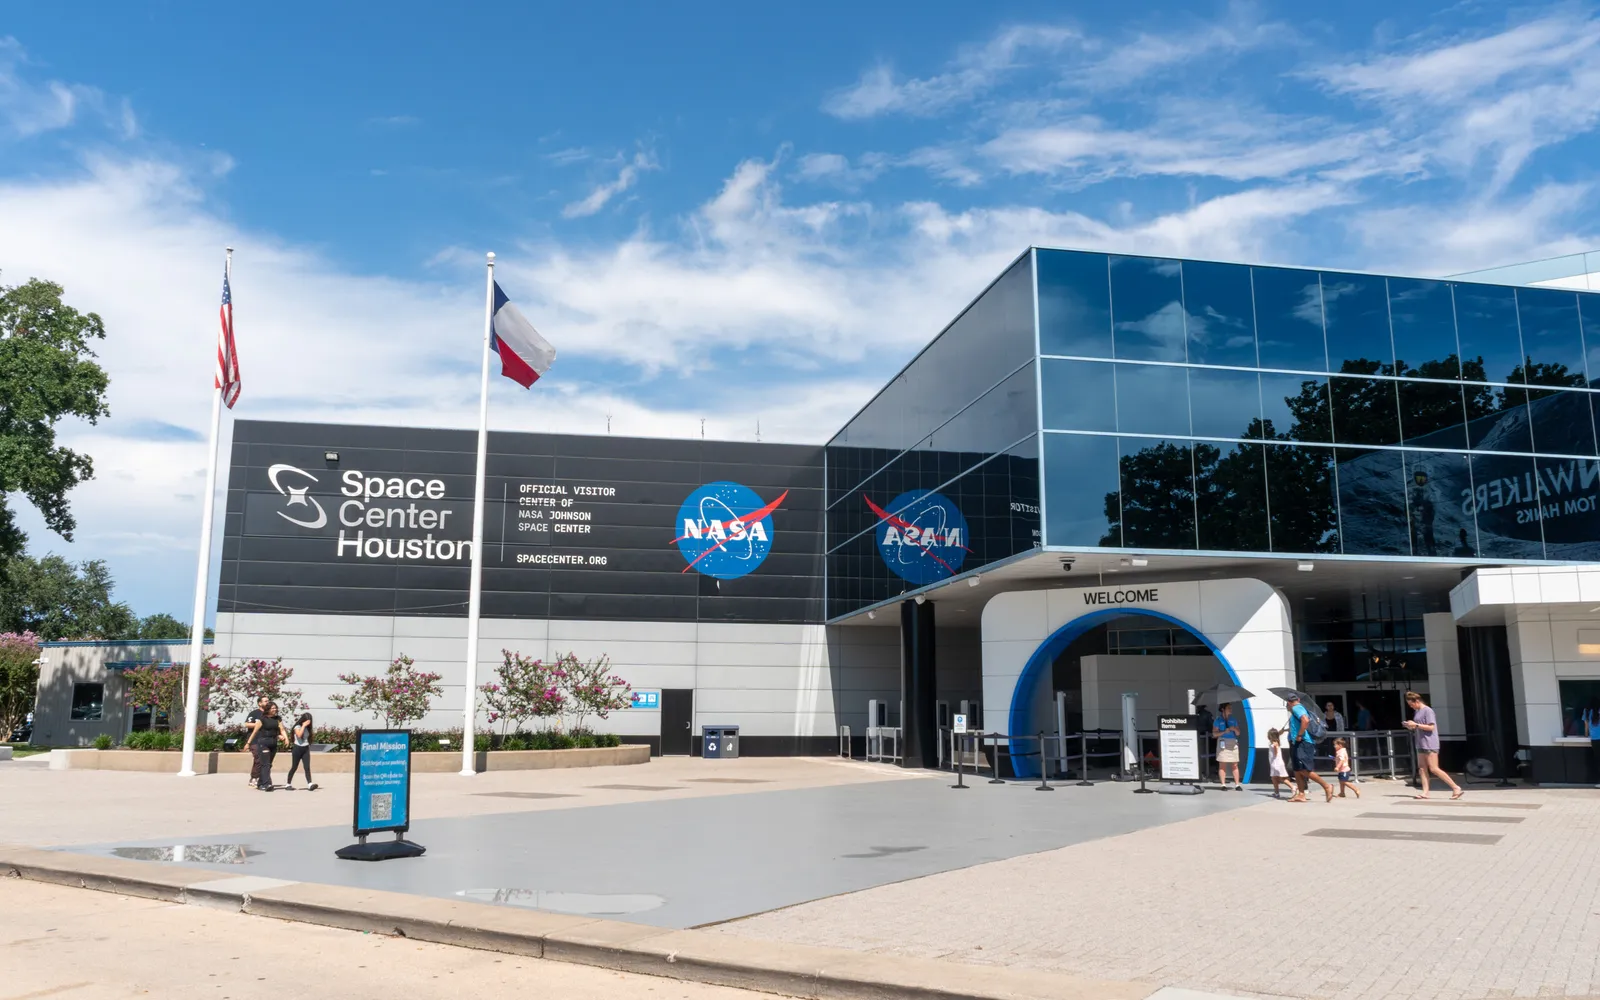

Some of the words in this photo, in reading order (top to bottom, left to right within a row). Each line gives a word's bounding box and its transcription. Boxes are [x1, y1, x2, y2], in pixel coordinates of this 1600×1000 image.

[340, 470, 446, 502] Space
[520, 484, 568, 494] OFFICIAL
[574, 486, 616, 496] VISITOR
[520, 497, 556, 506] CENTER
[561, 498, 574, 507] OF
[339, 500, 452, 530] Center
[518, 510, 543, 518] NASA
[549, 511, 591, 520] JOHNSON
[518, 522, 548, 532] SPACE
[554, 524, 590, 533] CENTER
[684, 518, 768, 542] NASA
[337, 530, 473, 560] Houston
[516, 554, 607, 565] SPACECENTER.ORG
[1084, 589, 1158, 604] WELCOME
[380, 742, 406, 750] Mission
